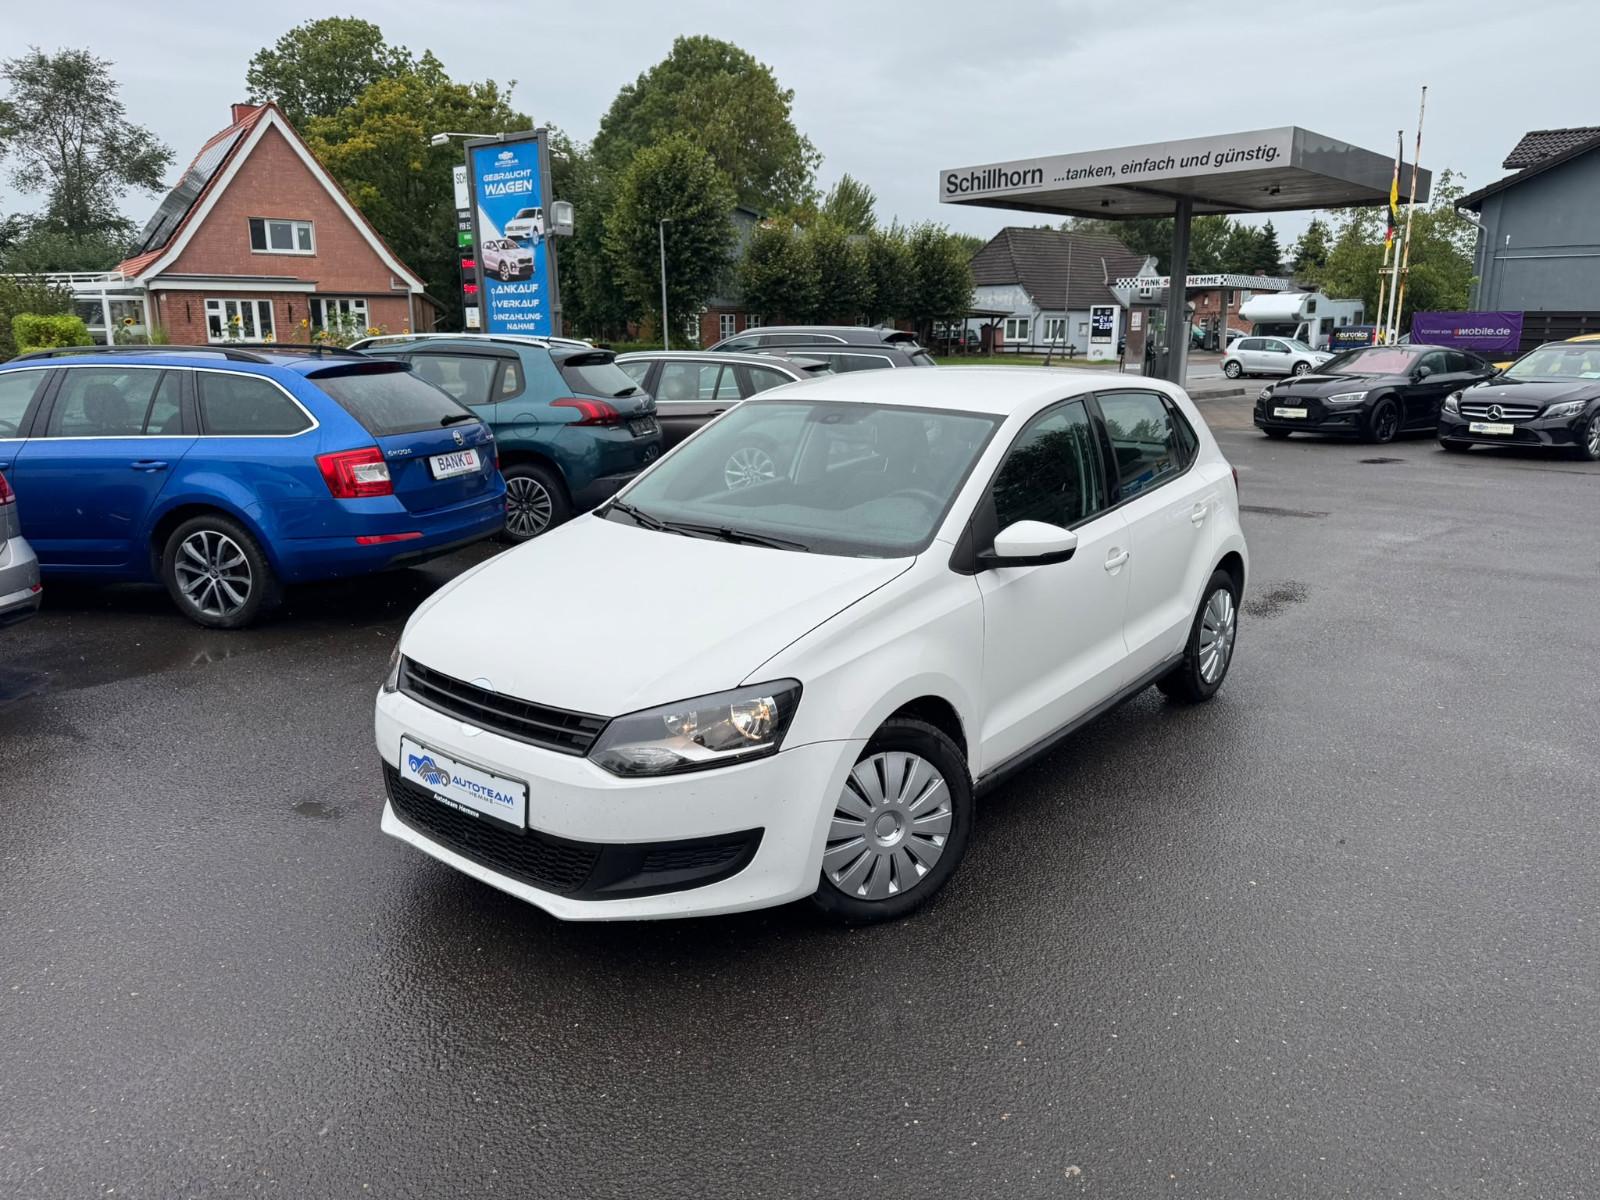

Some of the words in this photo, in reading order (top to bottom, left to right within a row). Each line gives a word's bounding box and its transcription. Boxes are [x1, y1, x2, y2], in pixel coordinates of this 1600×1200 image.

[946, 168, 1043, 194] Schillhorn
[1054, 163, 1116, 182] ...tanken,
[1121, 156, 1175, 174] einfach
[1180, 152, 1211, 168] und
[1214, 144, 1281, 167] günstig.
[483, 169, 531, 182] GEBRAUCHT
[485, 179, 533, 195] WAGEN
[1140, 279, 1160, 287] TANK
[1188, 276, 1219, 286] HEMME
[495, 283, 539, 294] ANKAUF
[496, 299, 540, 308] VERKAUF
[497, 313, 543, 321] INZAHLUNG-
[506, 322, 536, 330] NAHME
[452, 775, 514, 805] AUTOTEAM
